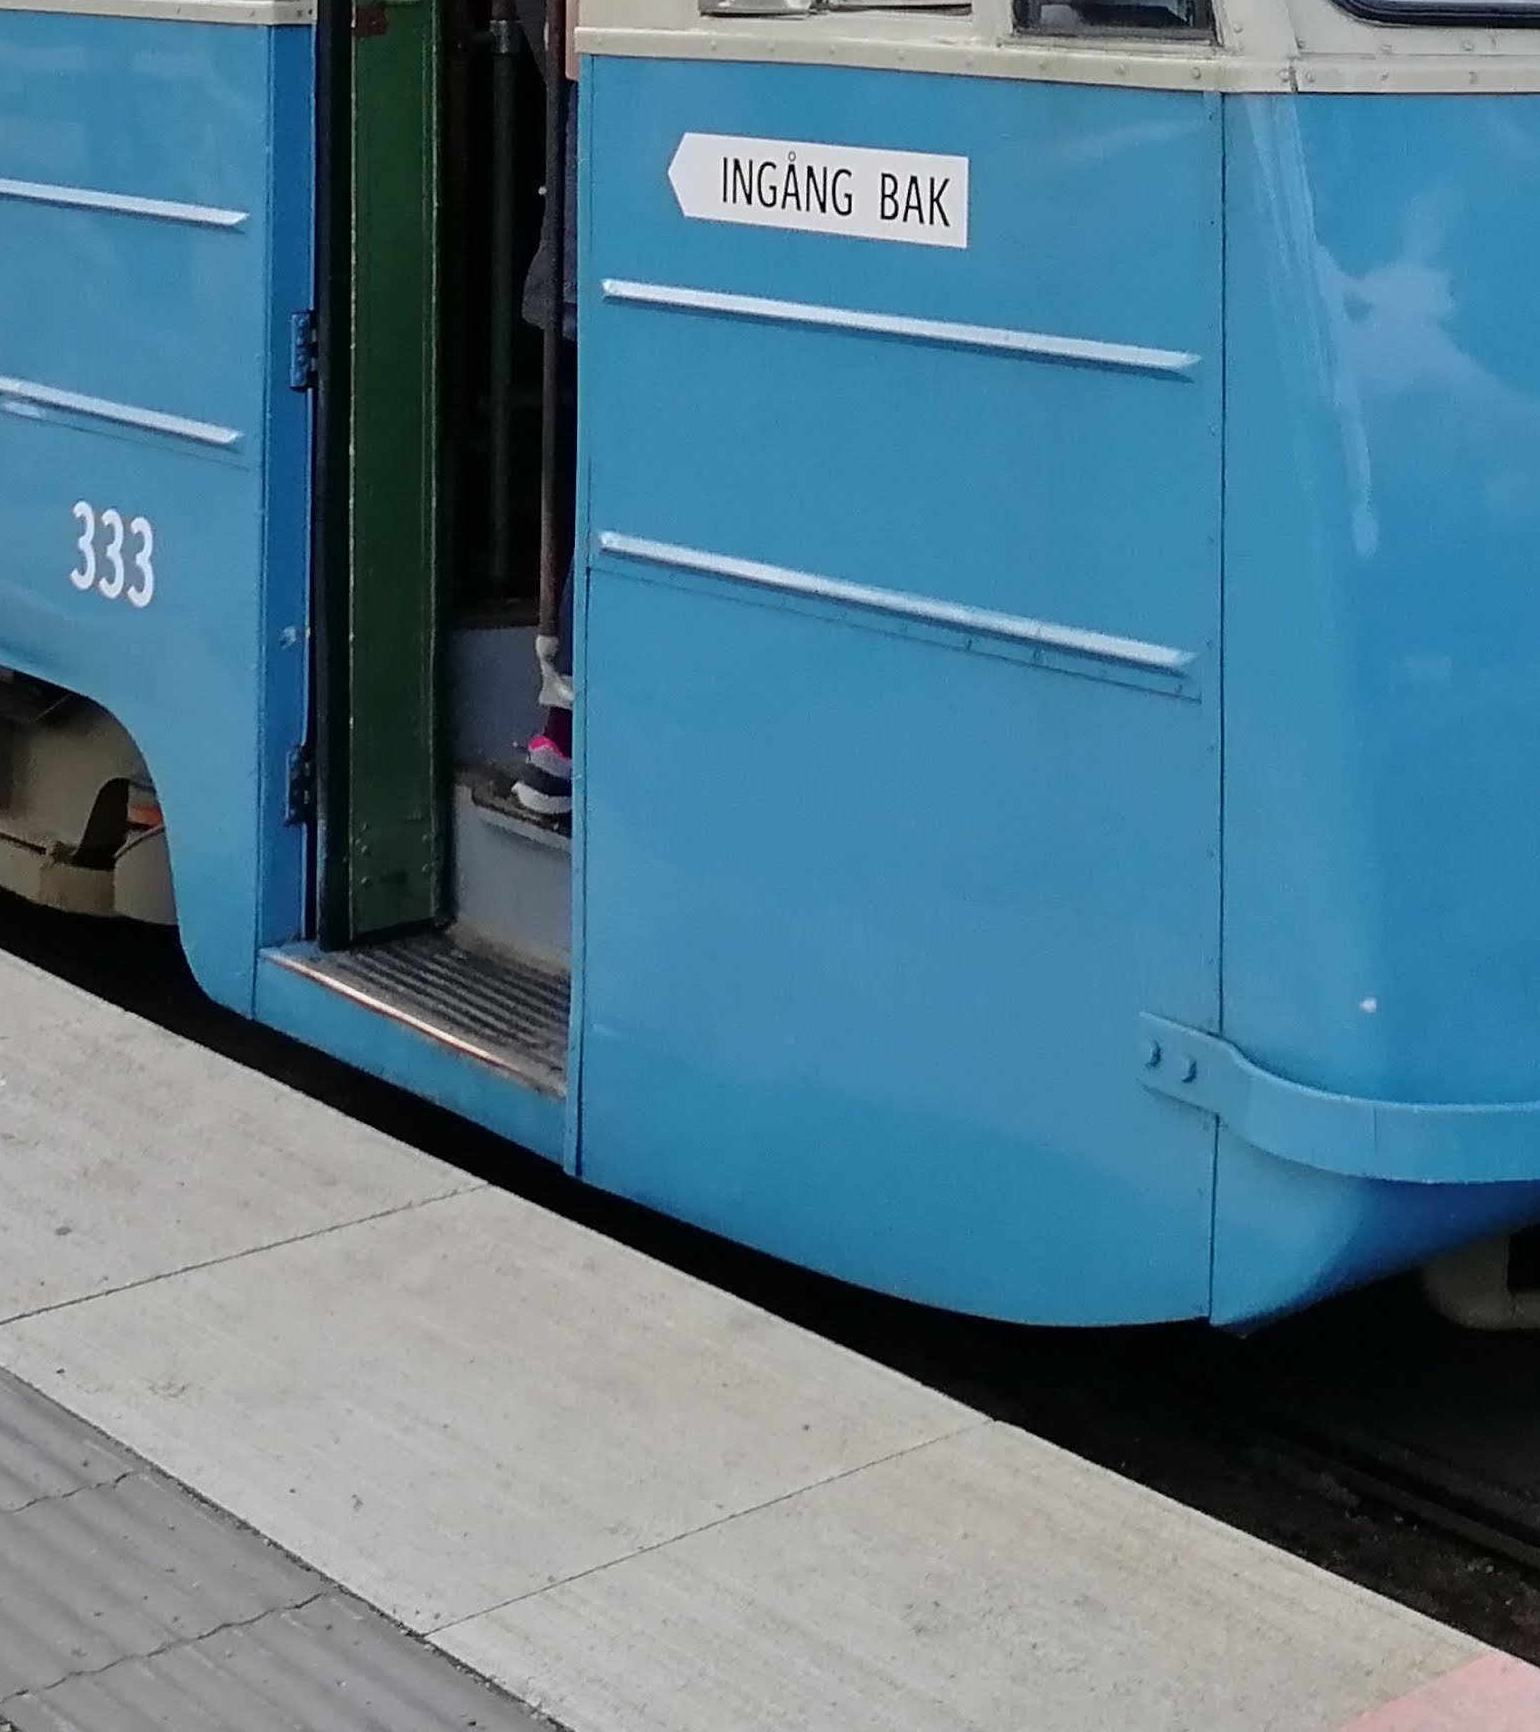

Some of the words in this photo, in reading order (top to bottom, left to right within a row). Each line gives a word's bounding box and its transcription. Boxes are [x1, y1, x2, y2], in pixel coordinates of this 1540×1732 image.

[722, 151, 853, 217] INGÅNG
[879, 172, 951, 228] BAK
[69, 500, 155, 609] 333
